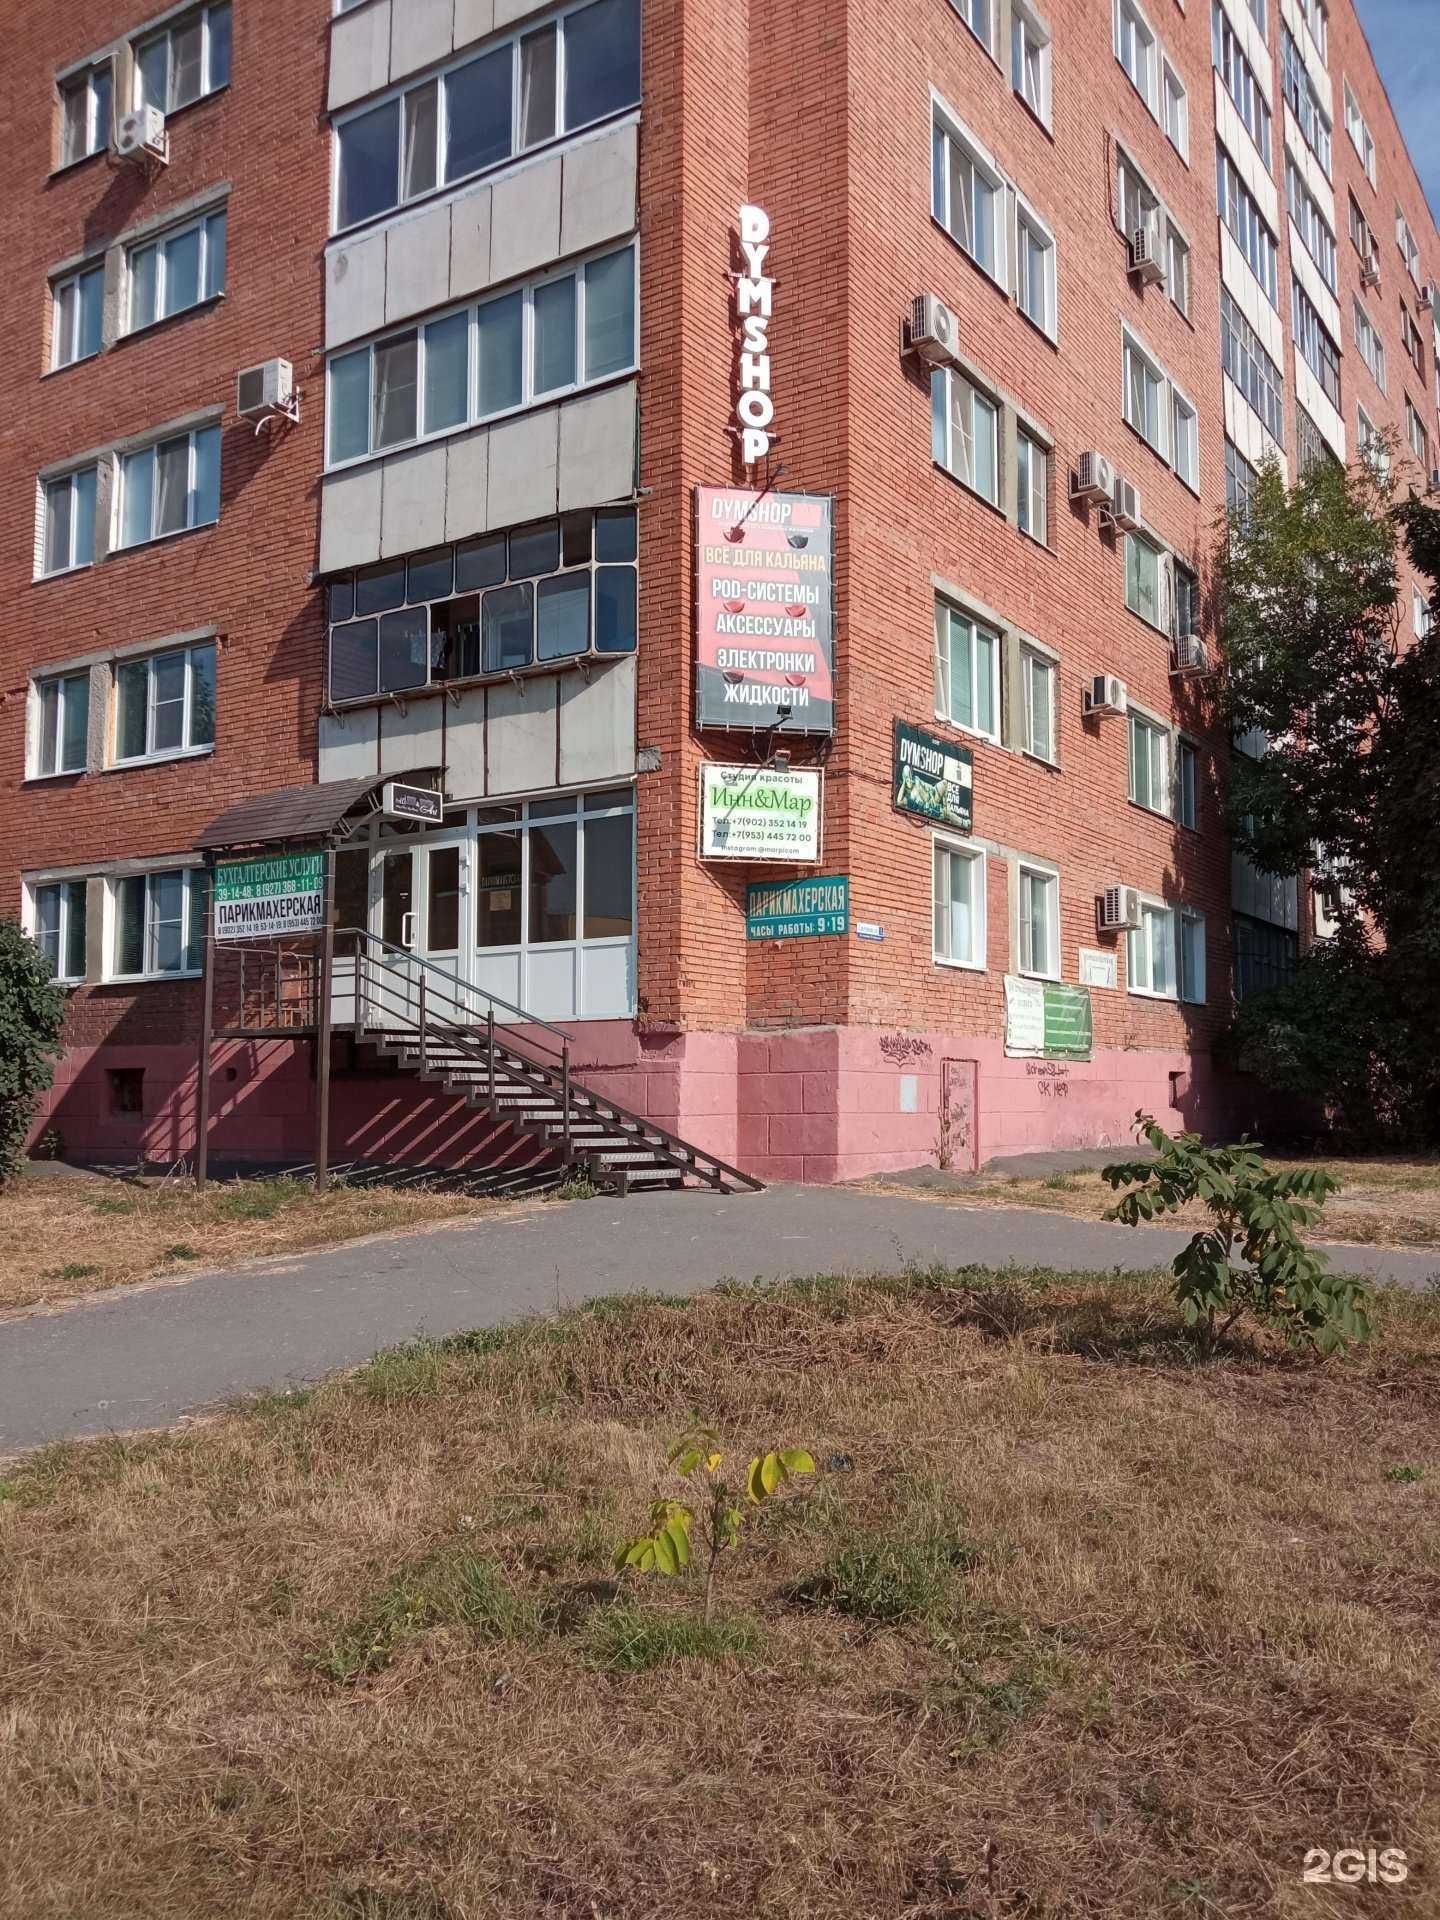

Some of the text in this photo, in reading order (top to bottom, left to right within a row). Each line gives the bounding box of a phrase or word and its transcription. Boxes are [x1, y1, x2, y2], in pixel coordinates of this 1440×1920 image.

[737, 204, 774, 464] DYMSHOP
[711, 497, 792, 524] DYMSHOP
[732, 549, 763, 567] ДЛЯ
[766, 551, 826, 571] КАЛЬЯНА
[712, 578, 819, 605] POD-СИСТЕМЫ
[716, 614, 815, 638] АКСЕССУАРЫ
[718, 648, 815, 673] ЭЛЕКТРОНКИ
[724, 683, 809, 707] ЖИДКОСТИ
[900, 738, 944, 775] DYMSHOP
[759, 774, 803, 785] красоты
[768, 819, 785, 828] 352
[799, 820, 807, 828] 19
[766, 832, 785, 841] 445
[786, 833, 797, 842] 72
[219, 895, 321, 924] ПАРИКМАХЕРСКАЯ
[750, 885, 845, 917] ПАРИКМАХЕРСКАЯ
[751, 925, 774, 937] ЧАСЫ
